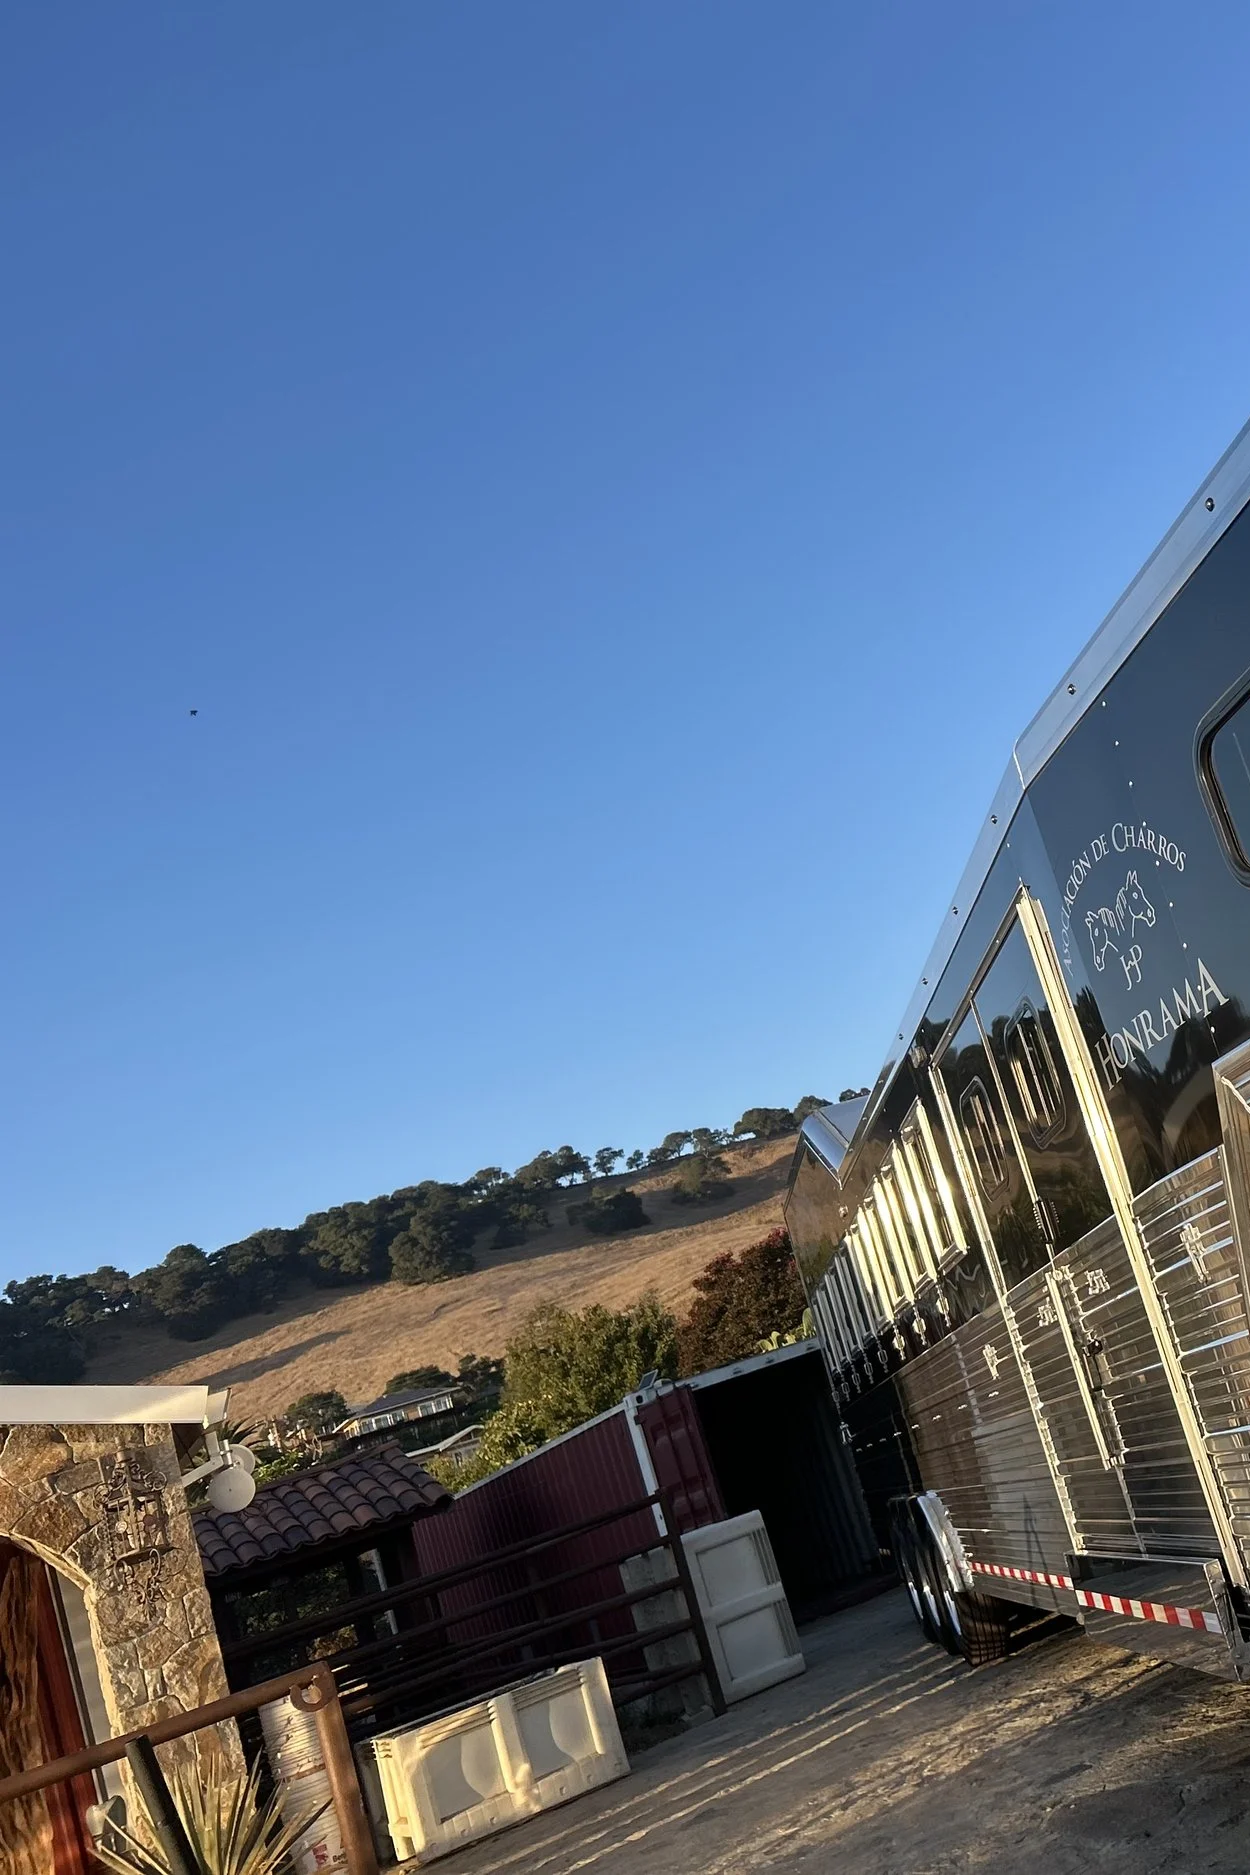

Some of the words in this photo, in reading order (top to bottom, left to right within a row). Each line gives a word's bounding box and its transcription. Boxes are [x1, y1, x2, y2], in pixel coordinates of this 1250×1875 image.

[1091, 833, 1110, 862] DE
[1111, 822, 1187, 872] CHARROS
[1094, 957, 1230, 1092] HONRAMA
